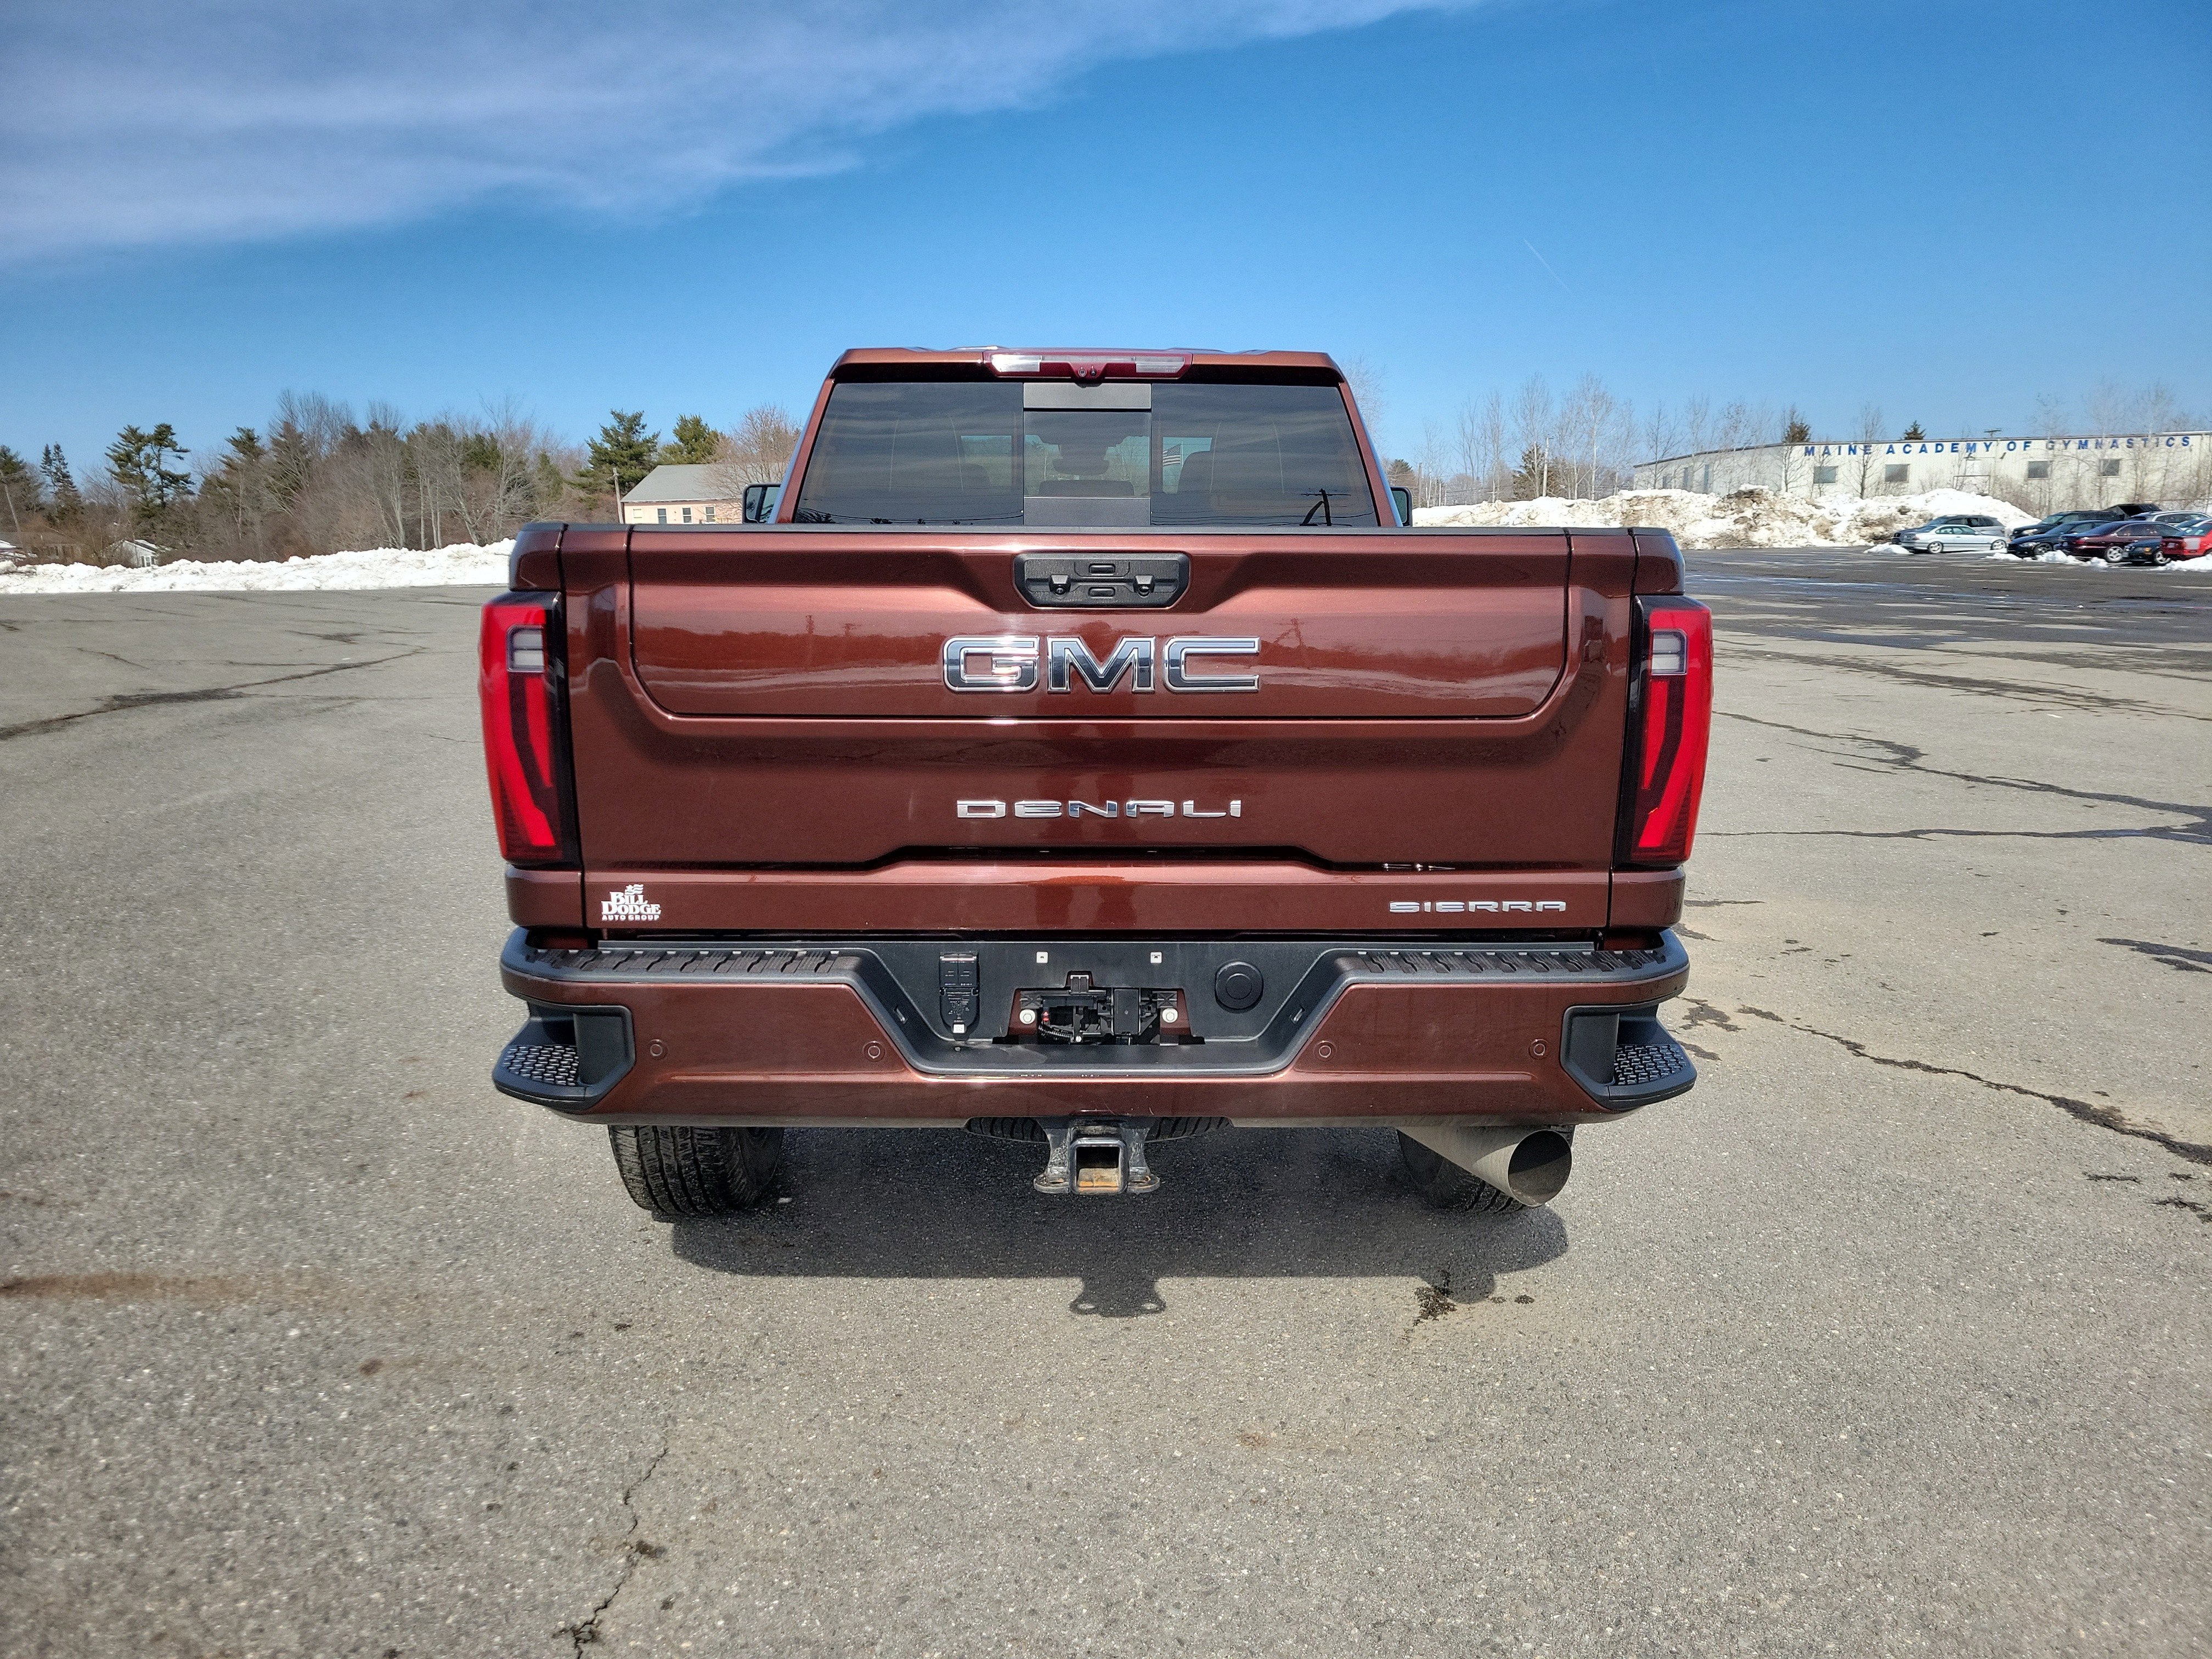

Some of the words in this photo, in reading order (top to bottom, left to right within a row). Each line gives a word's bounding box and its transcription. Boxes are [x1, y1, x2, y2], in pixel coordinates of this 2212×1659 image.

[1804, 443, 1872, 456] MAINE
[1886, 442, 1993, 454] ACADEMY
[2006, 441, 2032, 452] OF
[2046, 436, 2191, 451] GYMNASTICS
[943, 635, 1260, 693] GMC
[957, 800, 1242, 818] DENALI
[610, 891, 648, 905] BILL
[601, 901, 662, 915] DODGE
[1389, 900, 1566, 913] SIERRA
